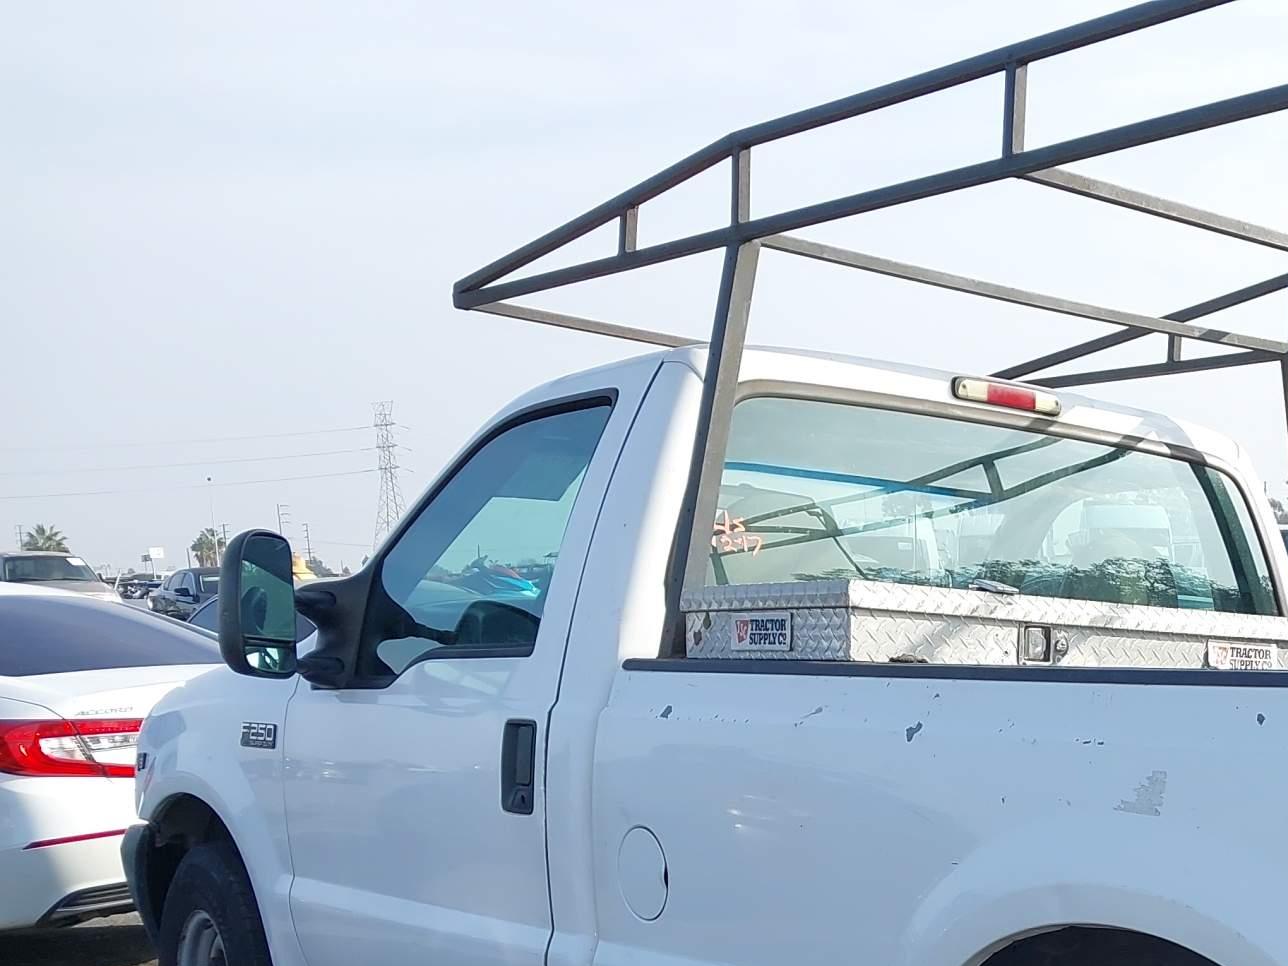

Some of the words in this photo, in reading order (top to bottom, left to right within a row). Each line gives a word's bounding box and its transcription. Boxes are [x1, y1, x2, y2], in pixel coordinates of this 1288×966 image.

[749, 618, 787, 631] TRACTOR
[748, 632, 777, 646] SUPPLY
[1230, 646, 1272, 659] TRACTOR
